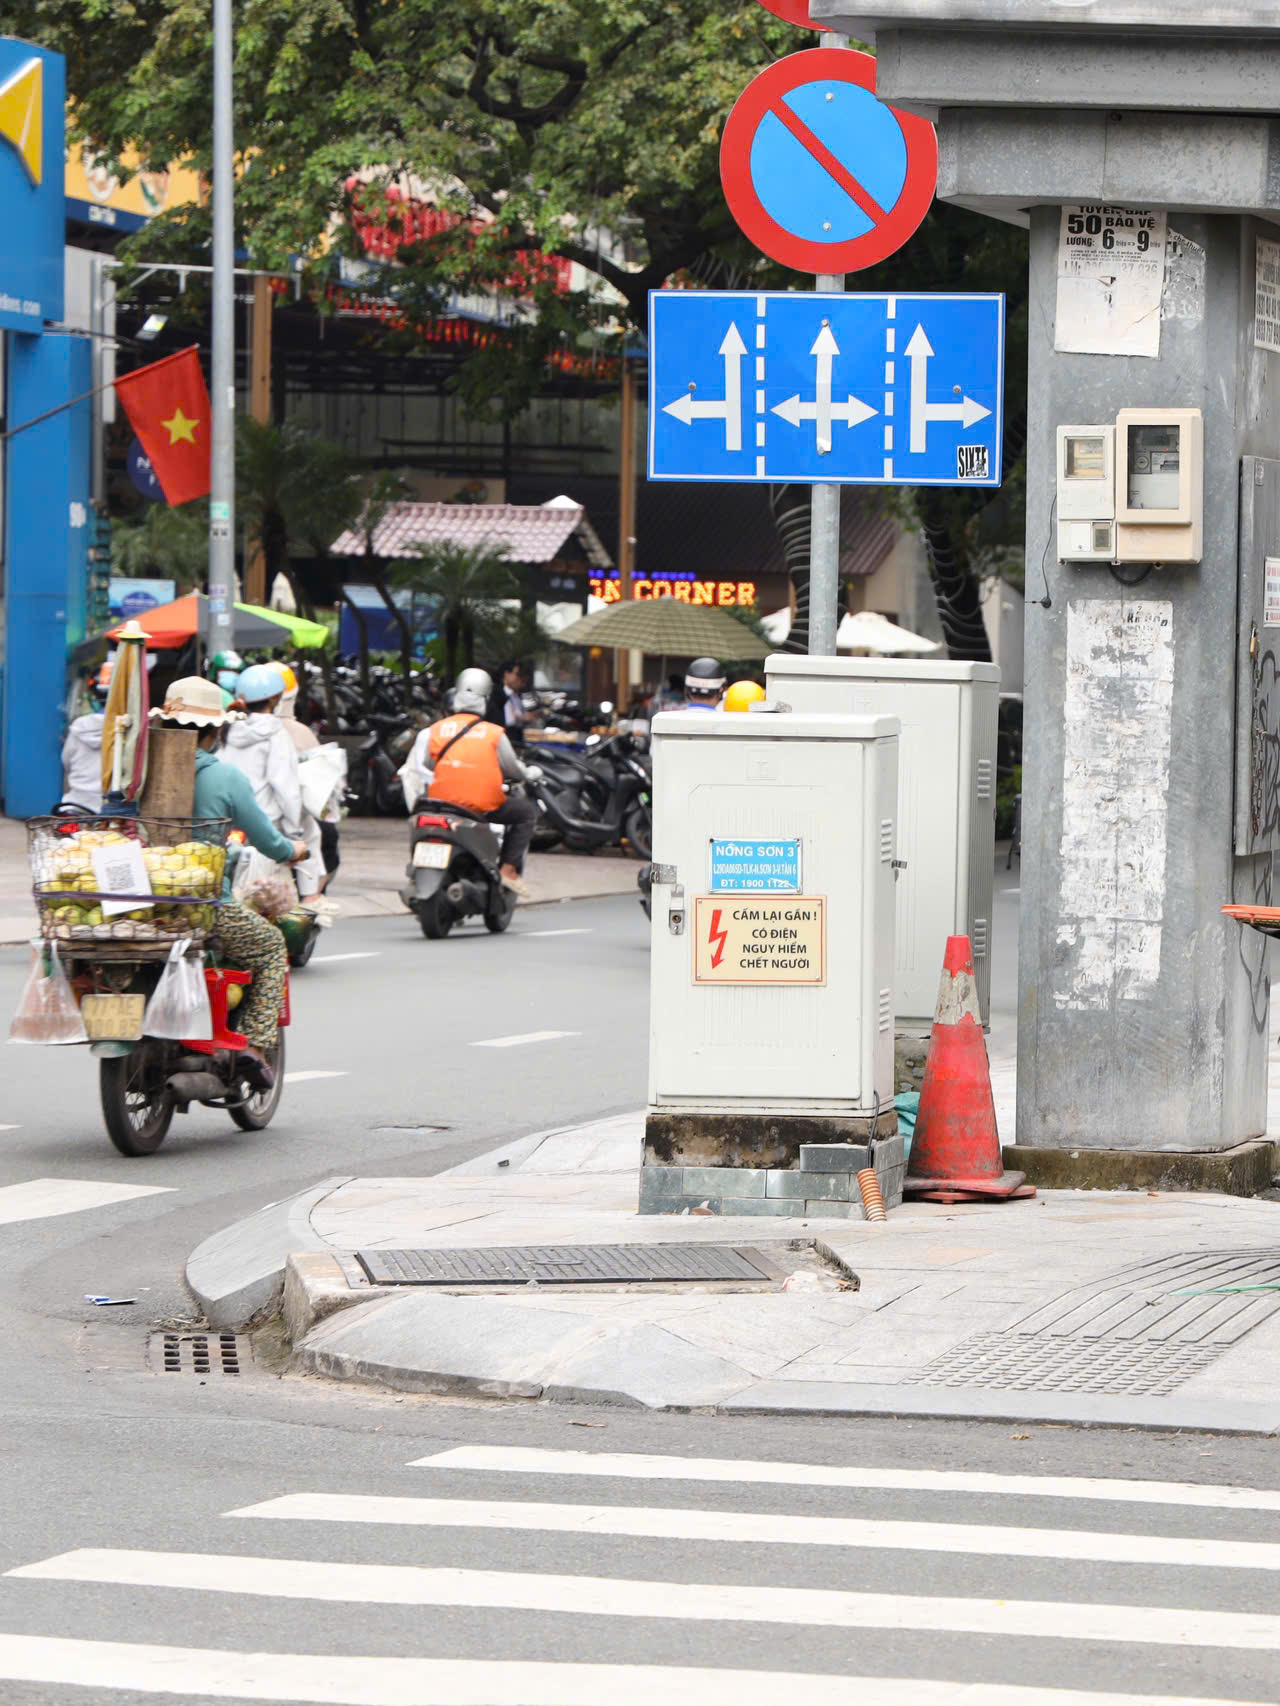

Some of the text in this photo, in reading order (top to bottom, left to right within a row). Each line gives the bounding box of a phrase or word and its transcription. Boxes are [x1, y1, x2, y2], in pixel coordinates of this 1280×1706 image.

[1067, 214, 1102, 235] 50
[1102, 228, 1115, 250] 6
[1137, 230, 1150, 252] 9
[633, 580, 756, 606] CORNER
[787, 846, 795, 857] 3
[720, 879, 738, 888] ĐT:
[741, 879, 764, 888] 1900
[732, 908, 760, 921] CẤM
[763, 911, 781, 923] LẠI
[752, 927, 798, 942] CÓ ĐIỆN
[742, 944, 775, 954] NGUY
[739, 956, 810, 969] CHẾT NGƯỜI
